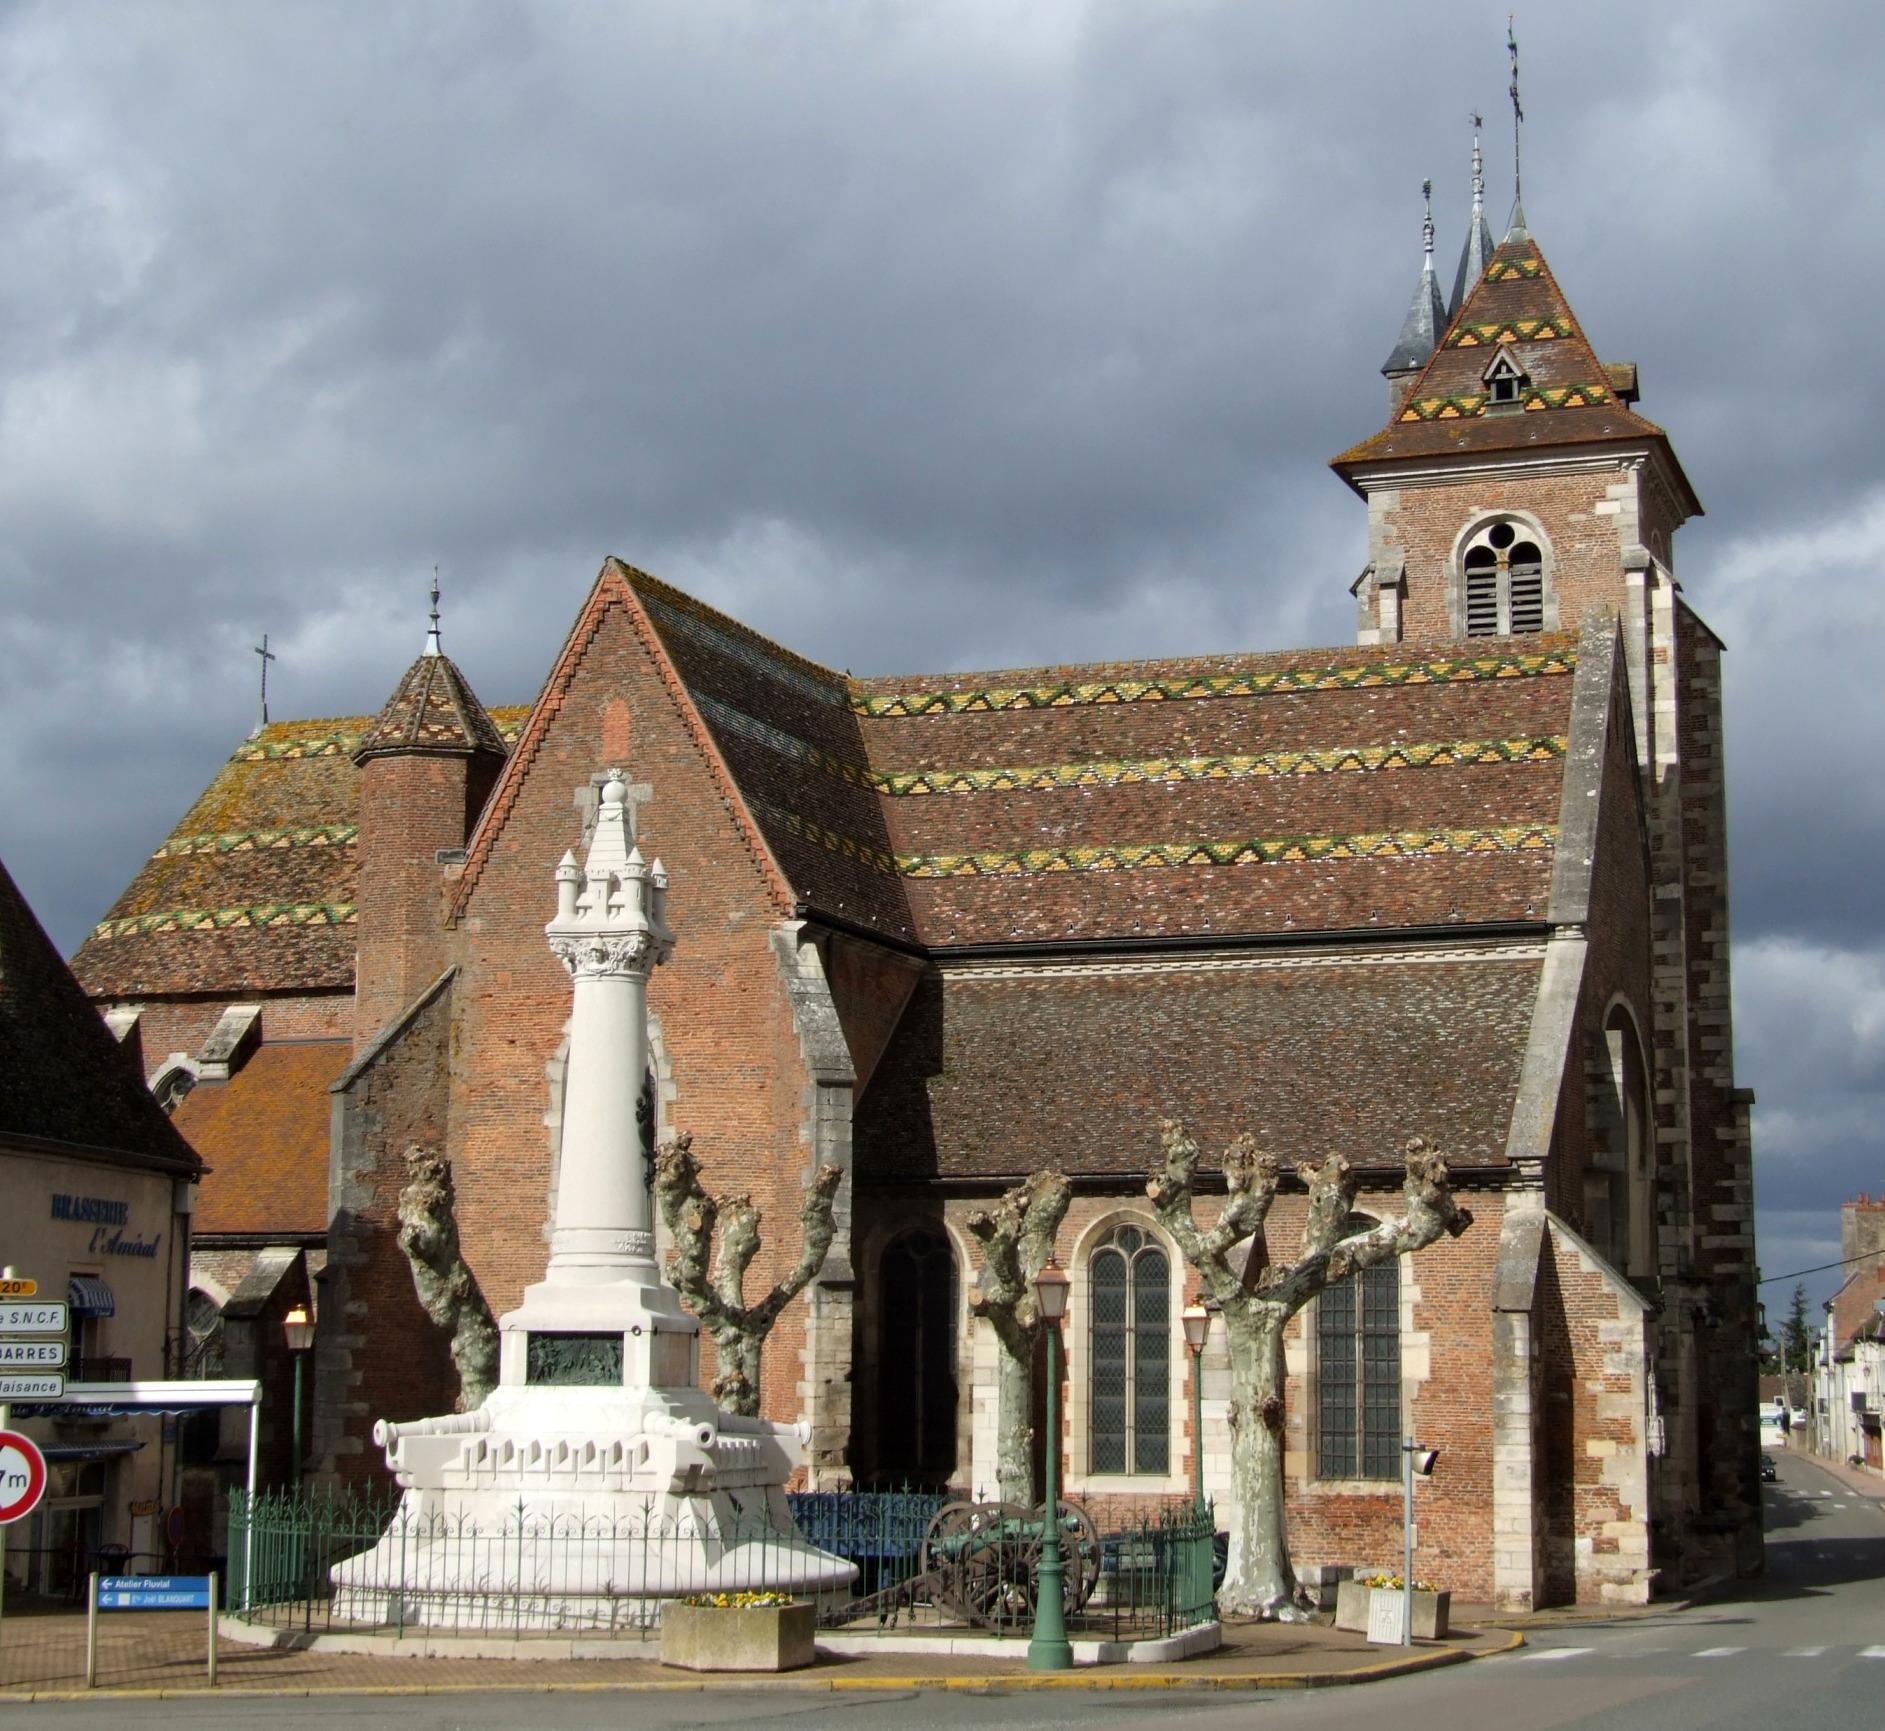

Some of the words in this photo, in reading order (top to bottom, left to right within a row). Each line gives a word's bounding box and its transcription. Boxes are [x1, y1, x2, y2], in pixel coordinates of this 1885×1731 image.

[52, 1193, 129, 1226] BRASSERIE
[0, 1347, 57, 1359] ARRES
[115, 1580, 142, 1589] Atelier
[143, 1580, 170, 1589] Fluvial
